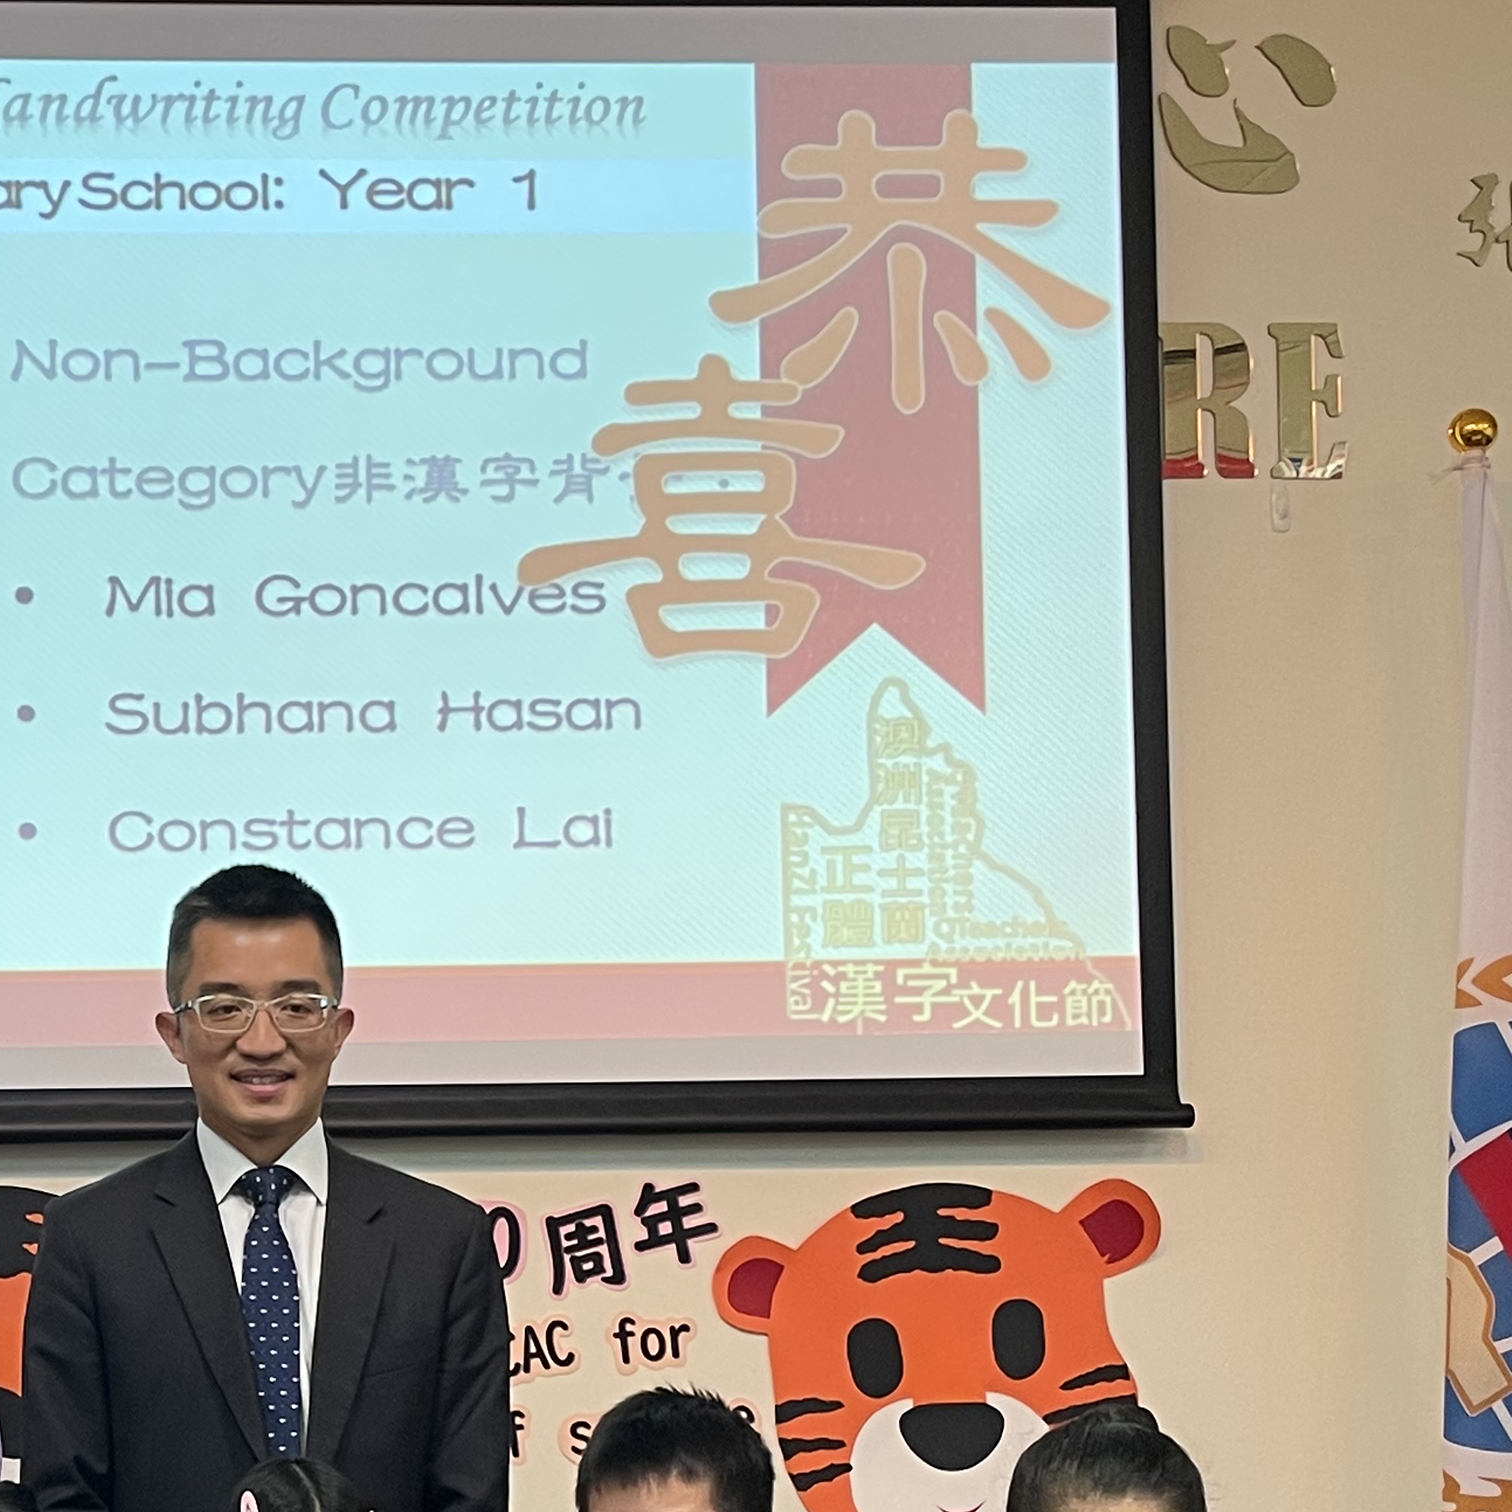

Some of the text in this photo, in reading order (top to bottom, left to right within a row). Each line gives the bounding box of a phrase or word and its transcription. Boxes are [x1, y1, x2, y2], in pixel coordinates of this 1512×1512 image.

[321, 81, 648, 141] Competition
[78, 171, 286, 213] School:
[320, 167, 474, 212] Year
[513, 171, 538, 212] 1
[10, 337, 589, 390] Non-Background
[105, 573, 607, 619] Mia Goncalves
[105, 690, 642, 738] Subhana Hasan
[107, 806, 614, 853] Constance Lai
[612, 1316, 691, 1365] for
